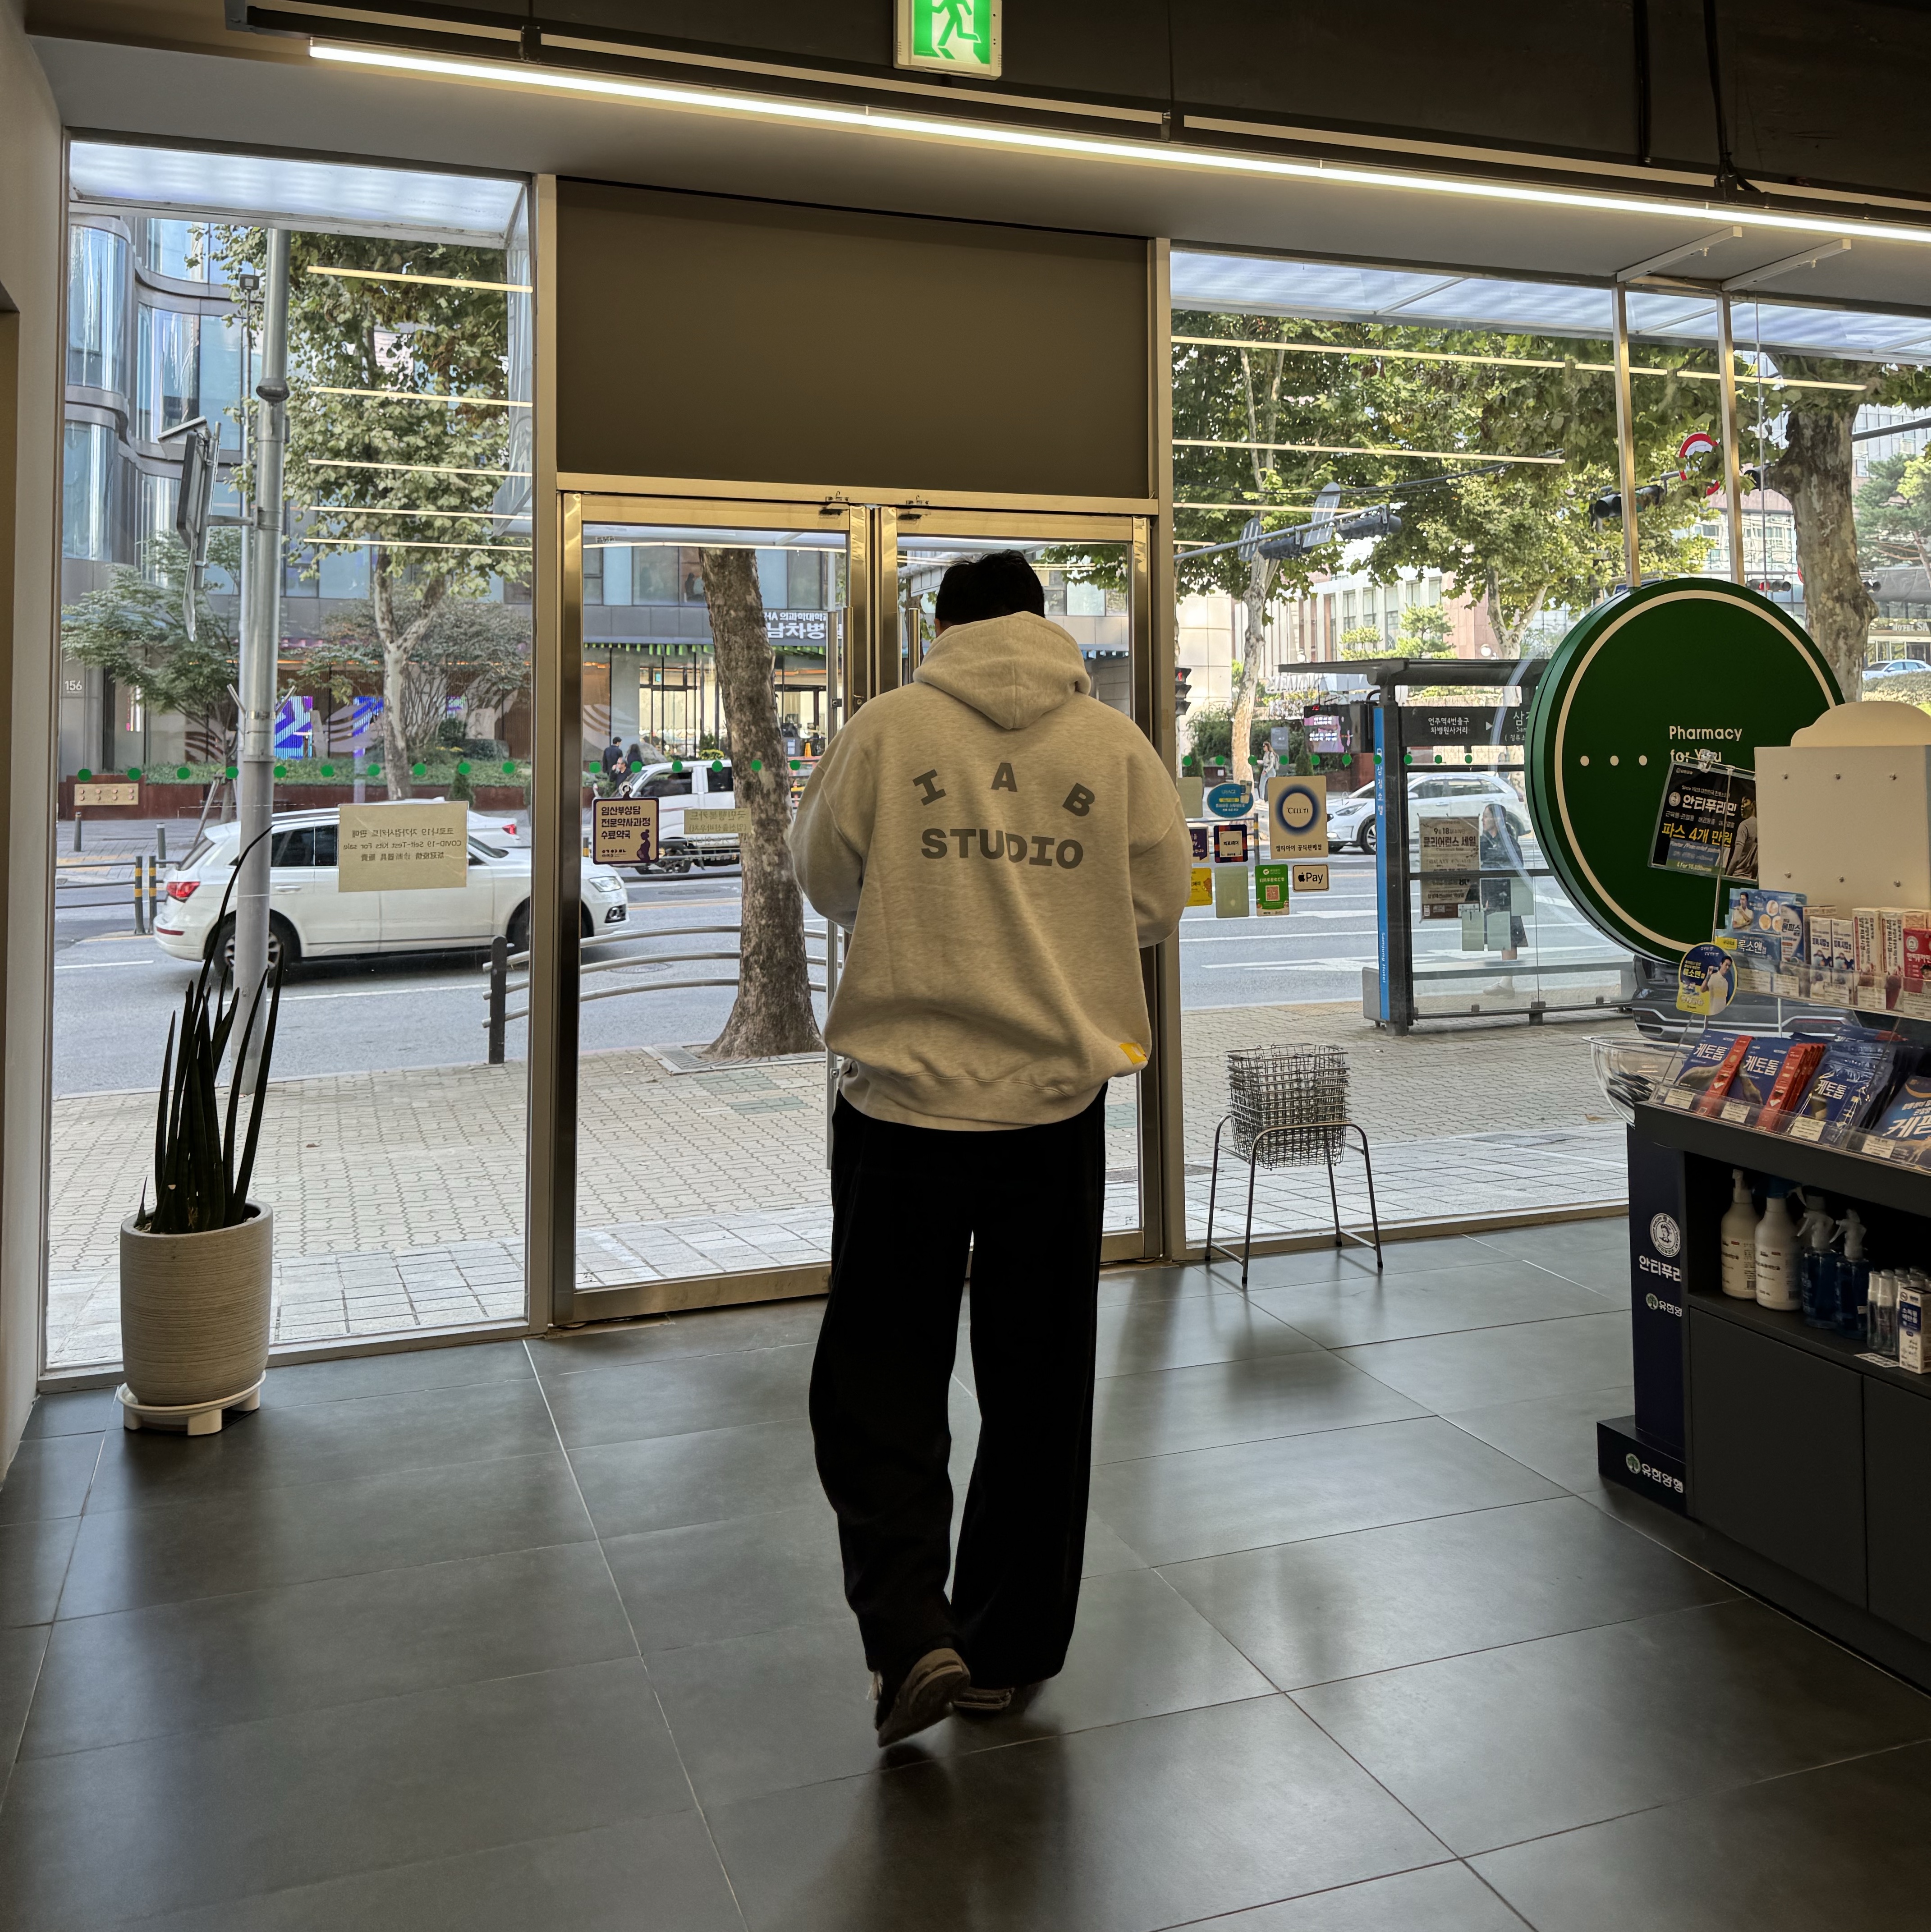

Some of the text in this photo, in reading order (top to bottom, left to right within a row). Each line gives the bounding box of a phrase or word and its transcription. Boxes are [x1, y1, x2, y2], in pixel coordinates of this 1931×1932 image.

[767, 622, 842, 639] 남차병
[64, 680, 83, 691] 156
[1428, 717, 1470, 726] 언주역4번출구
[1431, 726, 1468, 734] 차병원사거리
[1669, 726, 1743, 742] Pharmacy
[1670, 749, 1722, 762] for Yu
[601, 806, 641, 816] 임산부상담
[1682, 794, 1737, 817] 안티푸라민
[601, 817, 651, 827] 전문약사과정
[601, 830, 631, 840] 수료약국
[1424, 836, 1476, 847] 클리어런스 세일
[1661, 823, 1685, 839] 파스
[1688, 827, 1709, 844] 4개
[1711, 831, 1733, 847] 만원
[921, 828, 1083, 869] STUDIO
[1306, 872, 1323, 884] Pay
[1693, 1043, 1728, 1061] 케토톱
[1743, 1055, 1780, 1076] 케토톱
[1815, 1079, 1847, 1100] 케토톱
[1642, 1463, 1683, 1493] 유한양행
